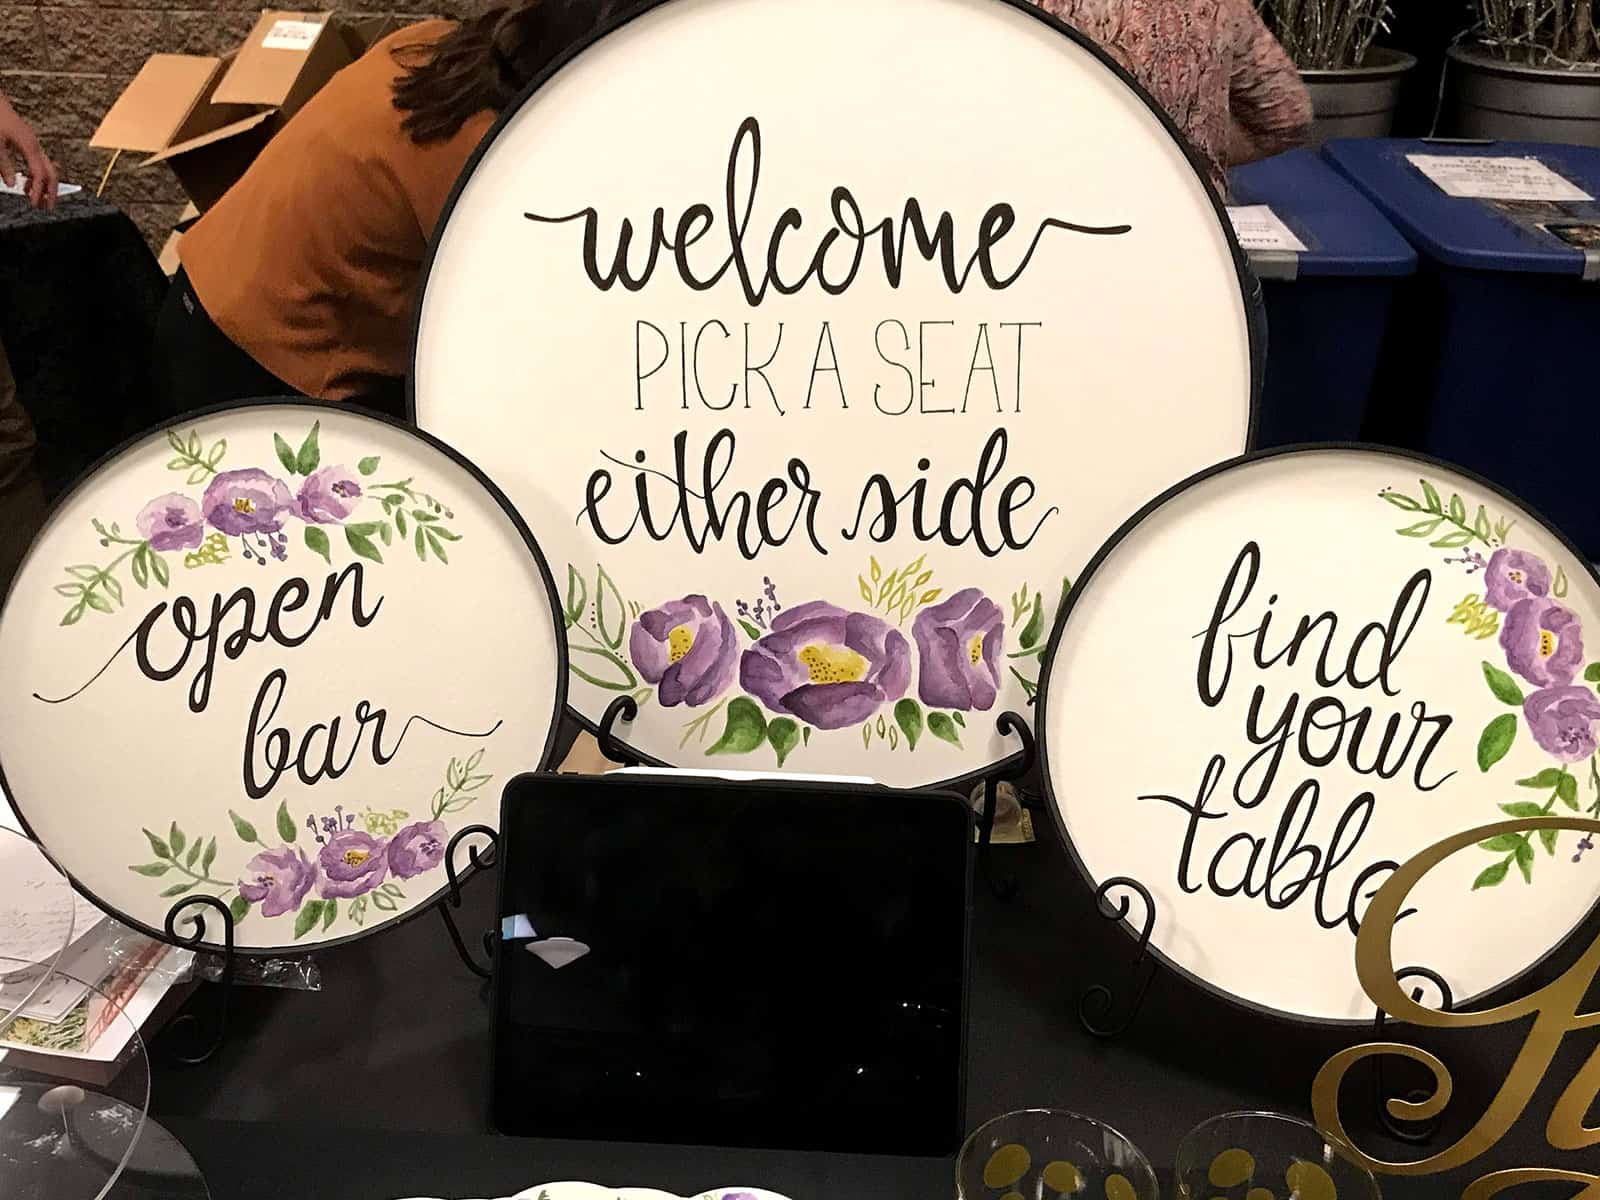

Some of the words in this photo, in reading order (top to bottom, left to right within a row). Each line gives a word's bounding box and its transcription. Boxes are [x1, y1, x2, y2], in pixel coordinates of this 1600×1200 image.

[524, 116, 1132, 307] welcome
[634, 319, 786, 416] PICK
[802, 321, 849, 410] A
[873, 319, 1043, 416] SEAT
[575, 428, 829, 561] either
[841, 427, 1060, 558] side
[32, 561, 385, 714] open
[1191, 540, 1432, 708] find
[243, 668, 504, 800] bar
[1232, 684, 1459, 810] your
